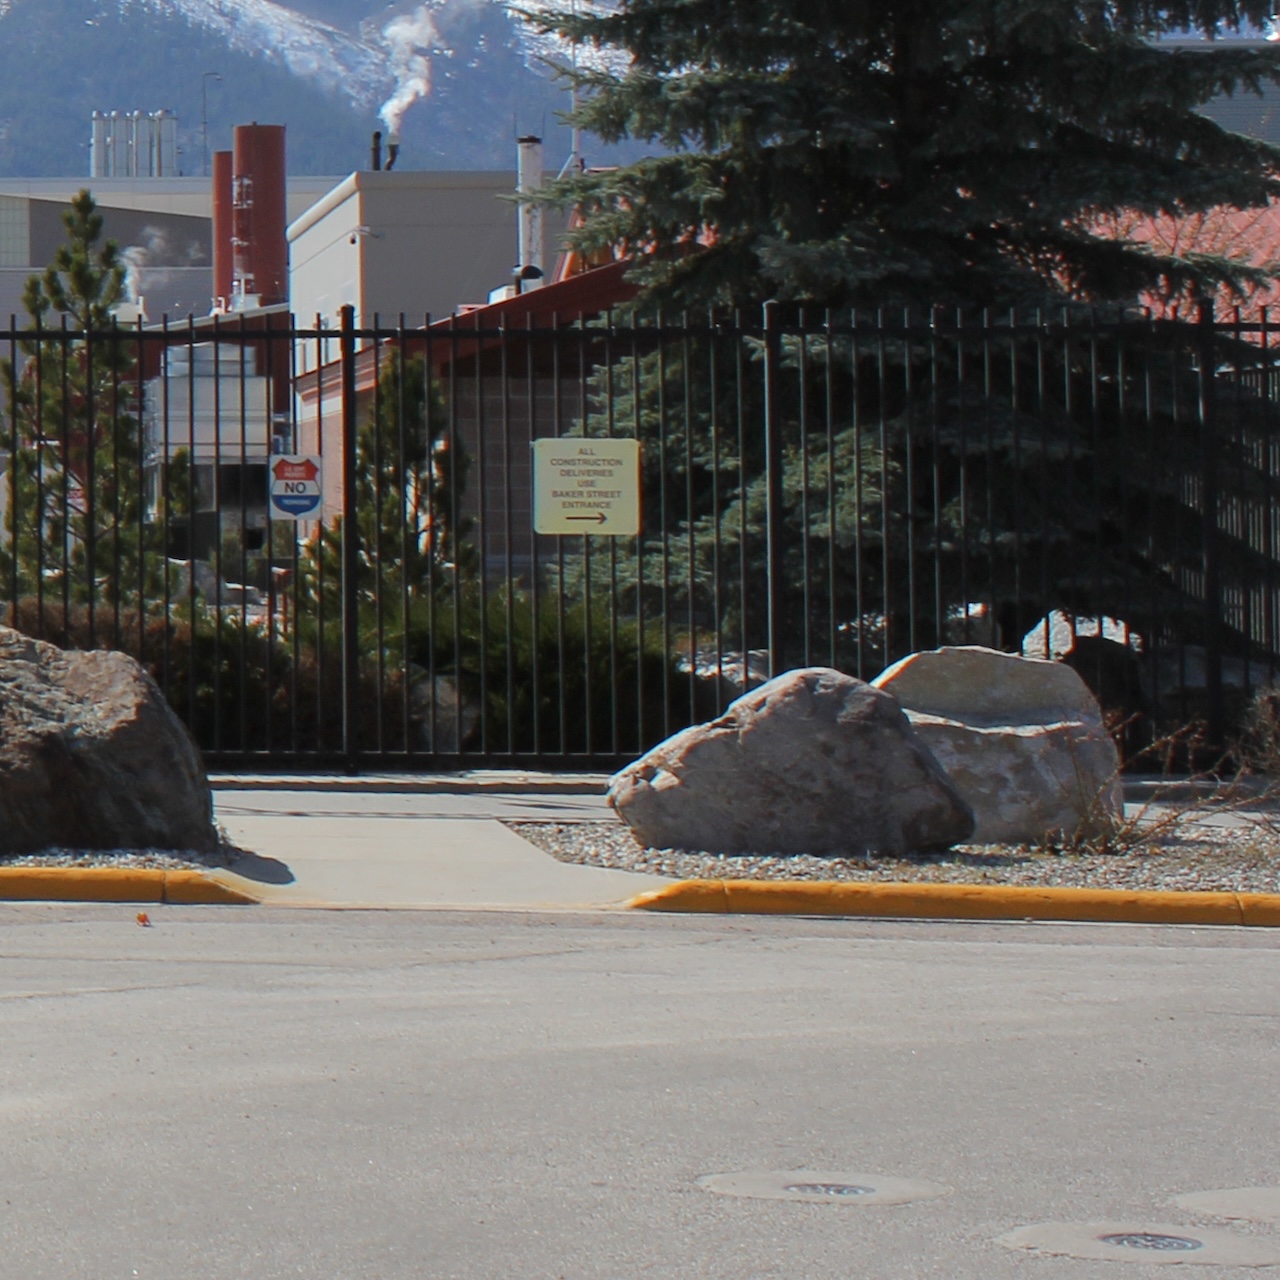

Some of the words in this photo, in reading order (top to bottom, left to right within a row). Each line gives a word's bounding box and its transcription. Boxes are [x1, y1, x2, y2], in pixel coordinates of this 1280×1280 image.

[578, 447, 596, 456] ALL
[550, 458, 623, 467] CONSTRUCTION
[559, 469, 614, 478] DELIVERIES
[284, 482, 307, 494] NO
[577, 480, 596, 488] USE
[552, 490, 584, 498] BAKER
[586, 490, 621, 498] STREET
[561, 501, 611, 509] ENTRANCE
